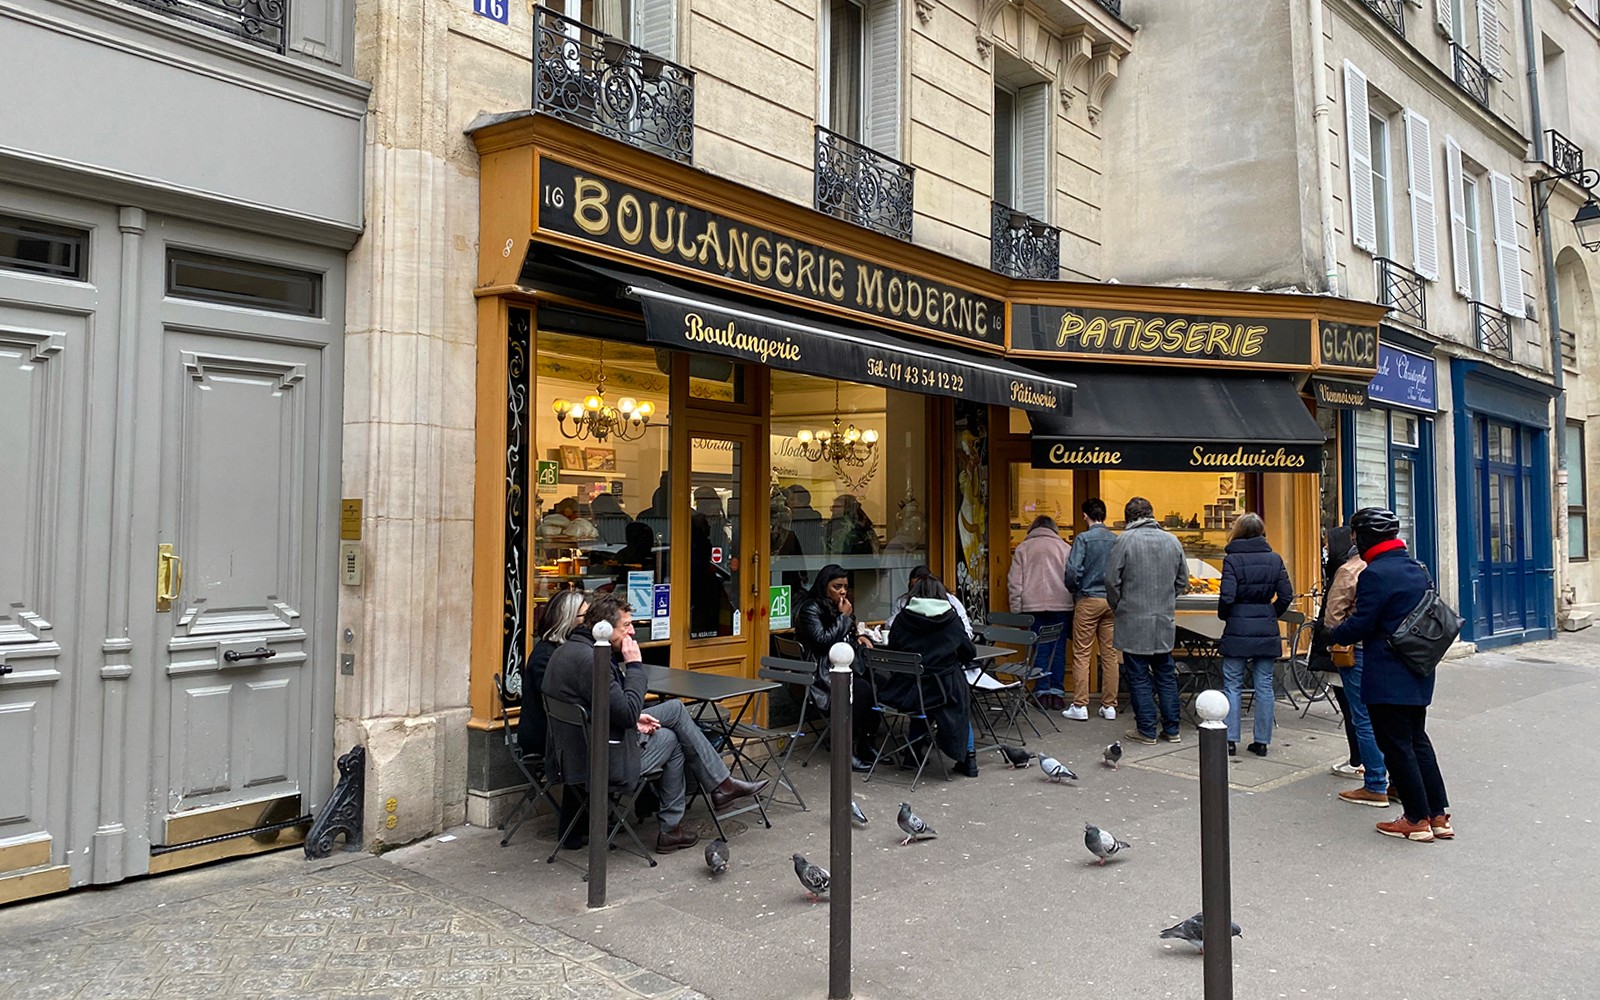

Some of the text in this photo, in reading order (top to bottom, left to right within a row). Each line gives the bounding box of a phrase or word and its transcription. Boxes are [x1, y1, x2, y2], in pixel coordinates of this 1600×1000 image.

[480, 0, 504, 19] 16
[545, 186, 564, 208] 16
[573, 176, 989, 338] BOULANGERIE MODERNE
[684, 312, 802, 363] Boulangerie
[1056, 311, 1269, 357] PATISSERIE
[1322, 328, 1374, 364] GLACE
[890, 363, 902, 381] 01
[904, 366, 919, 384] 43
[921, 369, 936, 387] 54
[938, 371, 950, 389] 12
[951, 374, 964, 392] 22
[1010, 380, 1057, 409] Pâtisserie
[1319, 383, 1364, 406] Viennoiserie
[1049, 443, 1122, 465] Cuisine
[1189, 446, 1305, 468] Sandwiches
[540, 468, 555, 484] AB
[770, 595, 787, 616] AB
